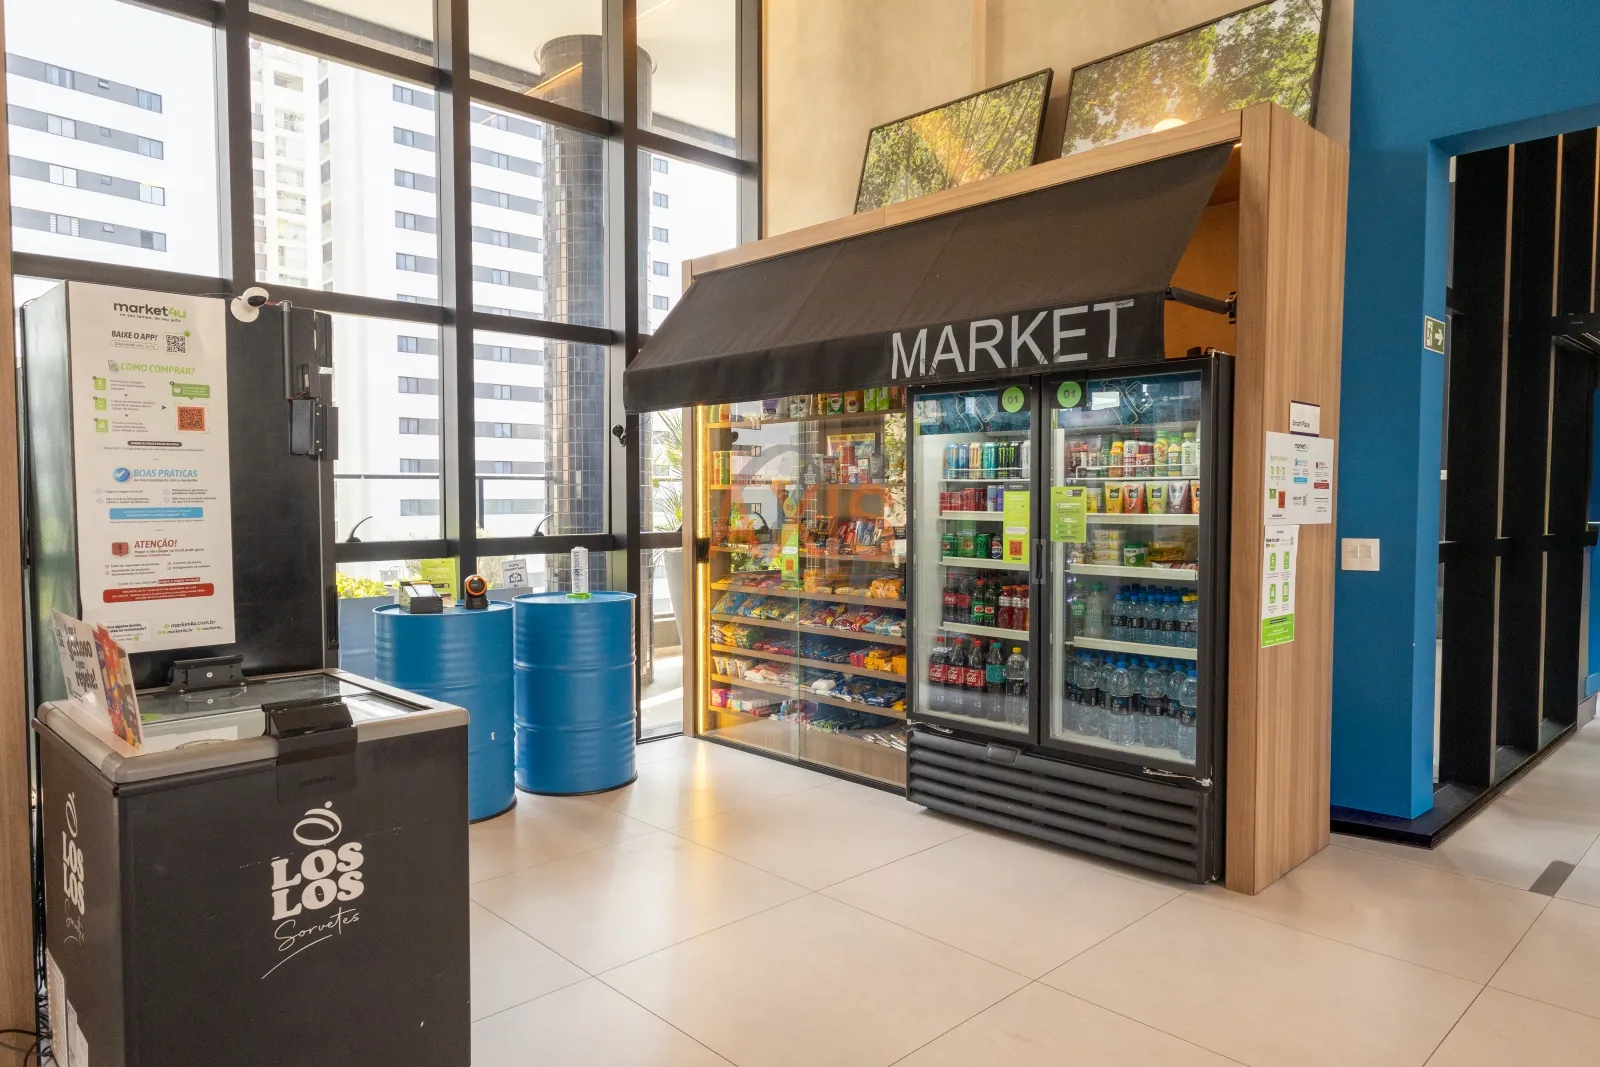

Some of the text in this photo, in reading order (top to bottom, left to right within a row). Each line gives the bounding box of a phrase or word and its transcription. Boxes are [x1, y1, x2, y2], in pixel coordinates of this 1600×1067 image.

[114, 302, 186, 318] market4u
[111, 331, 132, 339] BAIXE
[140, 333, 157, 341] APP!
[892, 299, 1134, 380] MARKET
[121, 362, 195, 375] COMO COMPRAR?
[1008, 395, 1018, 404] 01
[1064, 389, 1076, 399] 01
[158, 468, 198, 477] PRÁTICAS
[134, 538, 177, 549] ATENÇÃO!
[62, 831, 84, 882] LOS
[271, 842, 364, 890] LOS
[63, 862, 85, 915] LOS
[272, 871, 364, 920] LOS
[274, 907, 360, 951] Sorvetes
